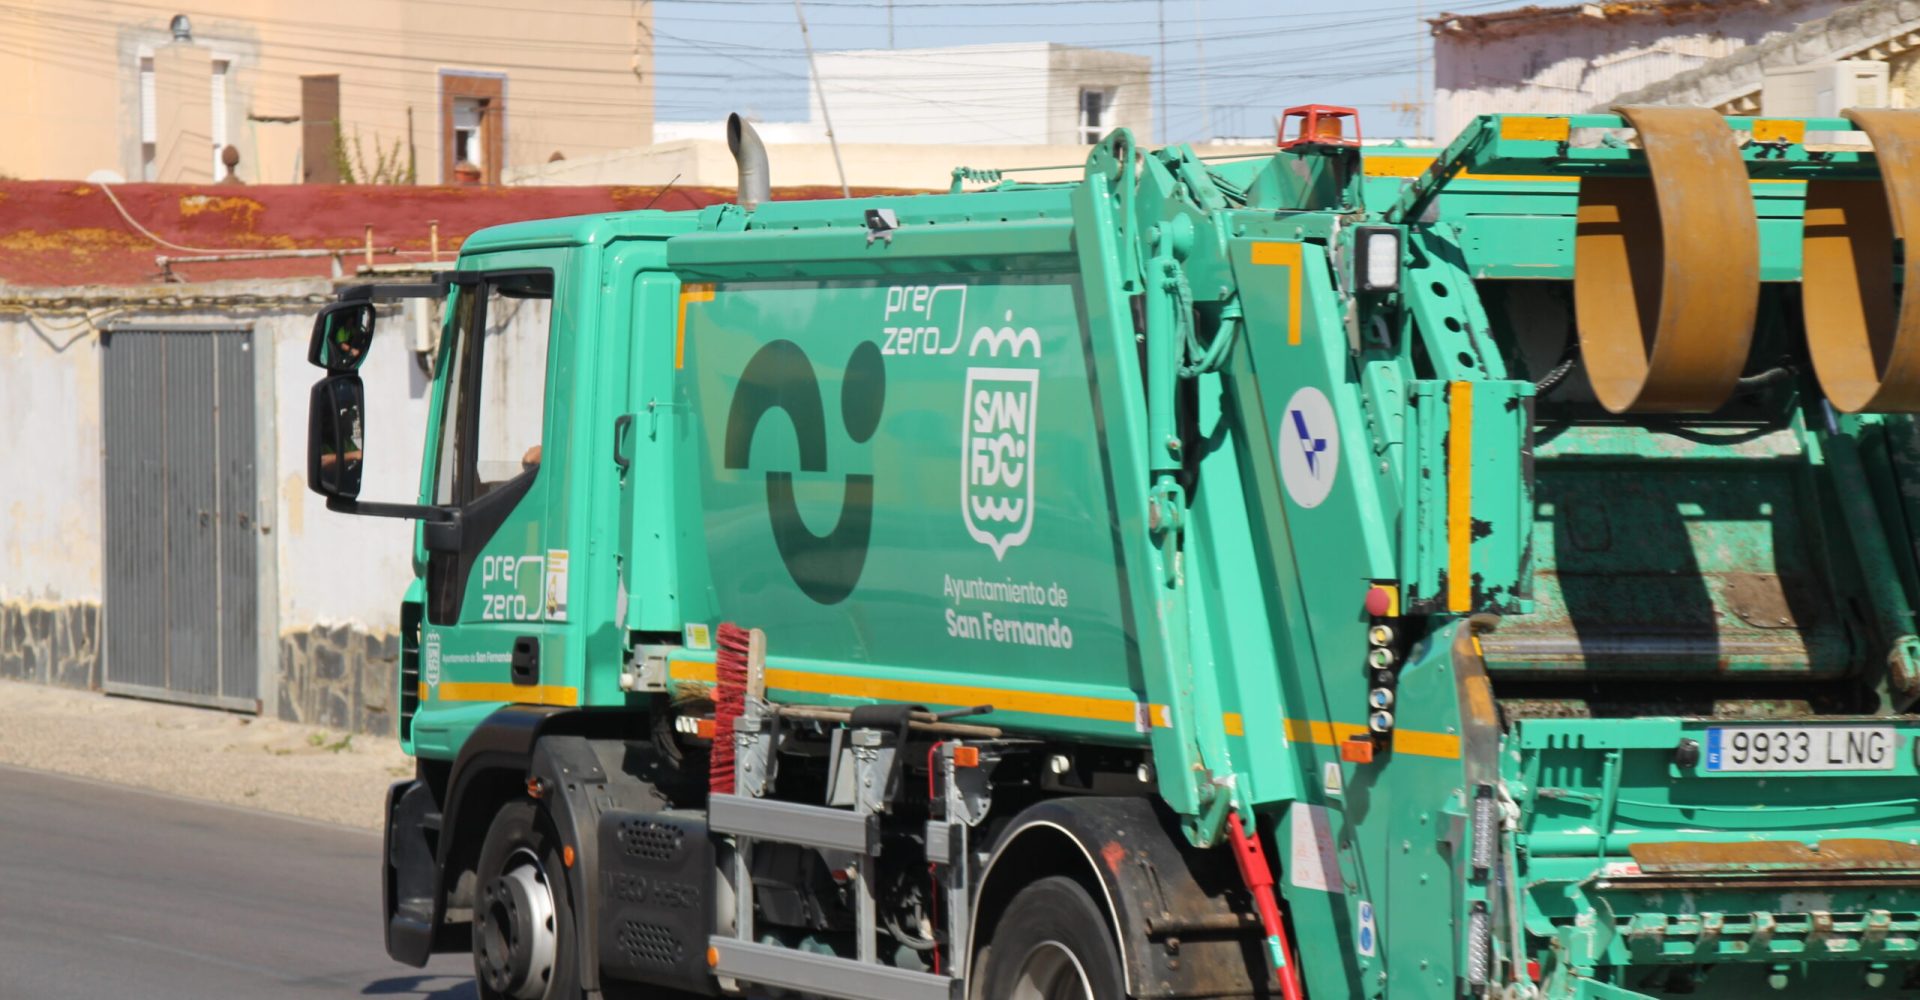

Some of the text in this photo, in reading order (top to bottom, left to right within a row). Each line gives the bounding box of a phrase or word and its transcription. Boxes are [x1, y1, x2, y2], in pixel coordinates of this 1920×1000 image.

[884, 285, 930, 321] pre
[881, 326, 940, 355] zero
[973, 389, 1027, 434] SAN
[482, 556, 515, 589] pre
[482, 595, 526, 620] zero
[943, 573, 1068, 608] Ayuntamiento de
[945, 608, 1073, 649] San Fernando
[476, 651, 487, 664] San
[1709, 731, 1886, 765] E 9933 LNG
